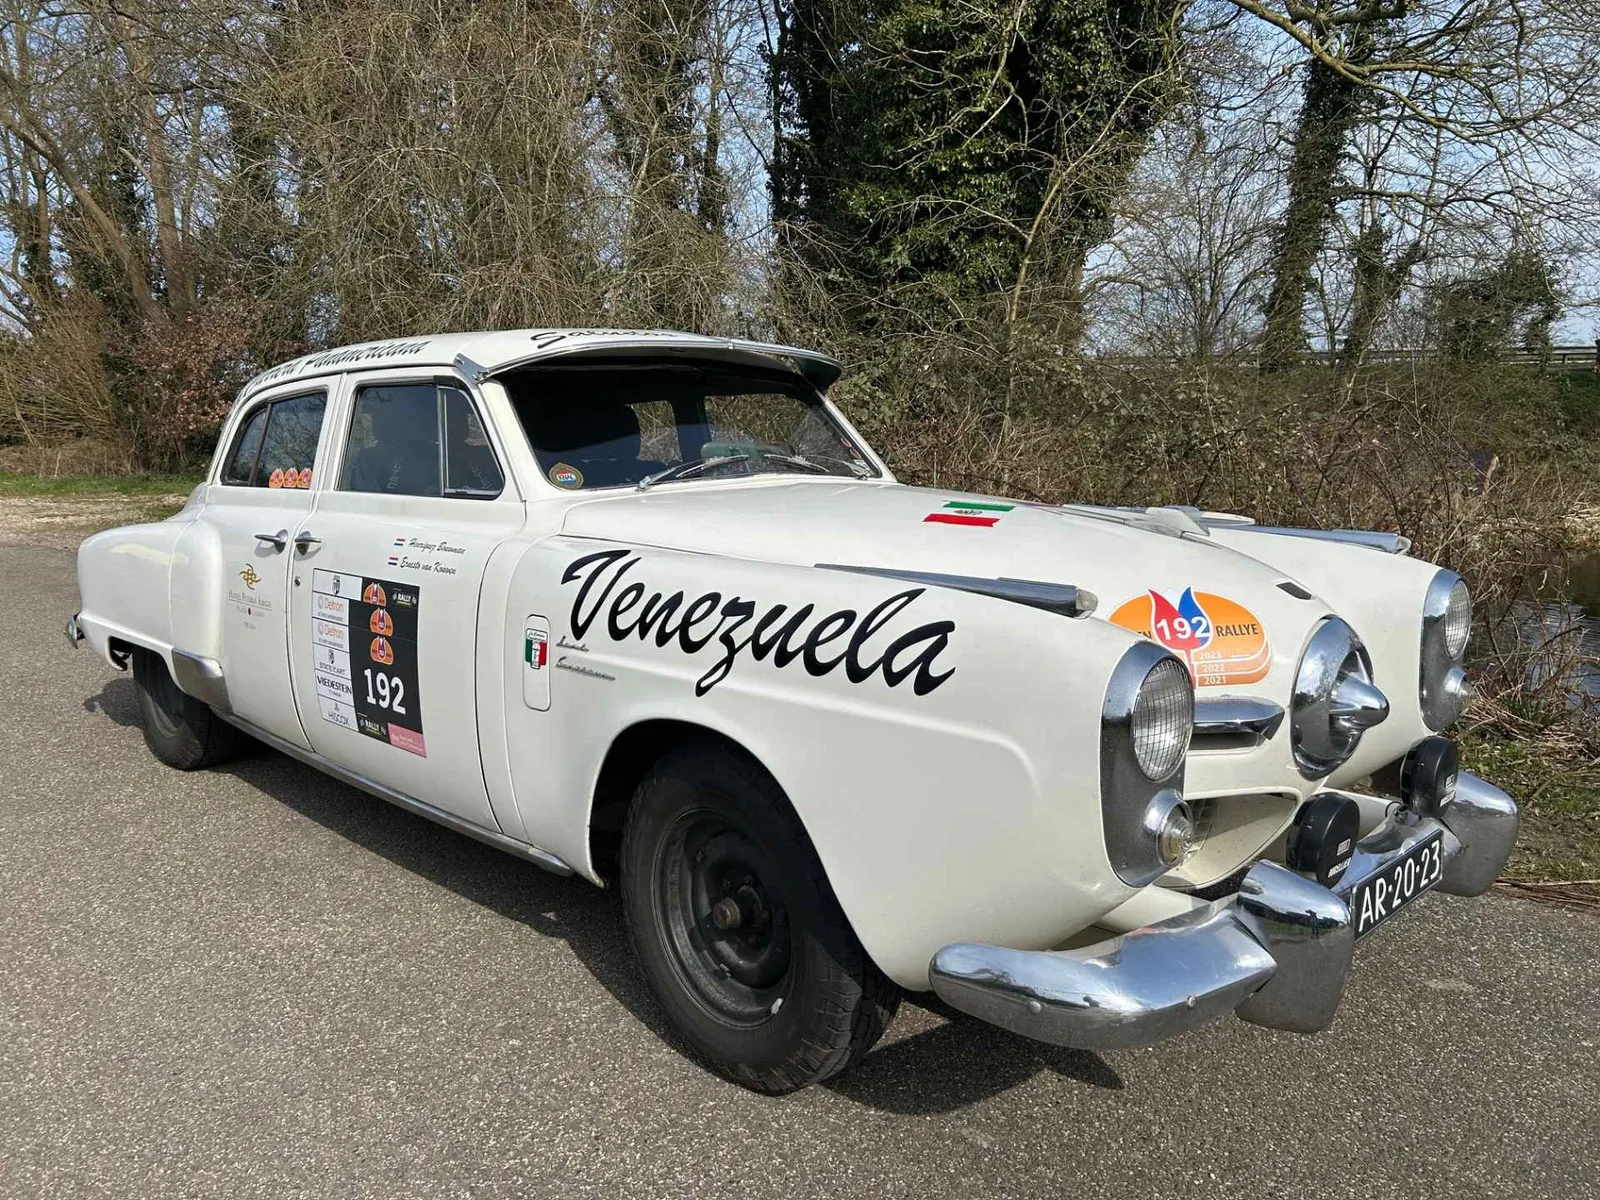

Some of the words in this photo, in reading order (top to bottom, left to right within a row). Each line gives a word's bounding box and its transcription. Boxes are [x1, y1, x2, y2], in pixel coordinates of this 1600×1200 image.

[561, 549, 956, 697] Venezuela
[1155, 616, 1212, 641] 192
[1216, 623, 1259, 638] RALLYE
[364, 668, 406, 714] 192
[1204, 675, 1227, 685] 2021
